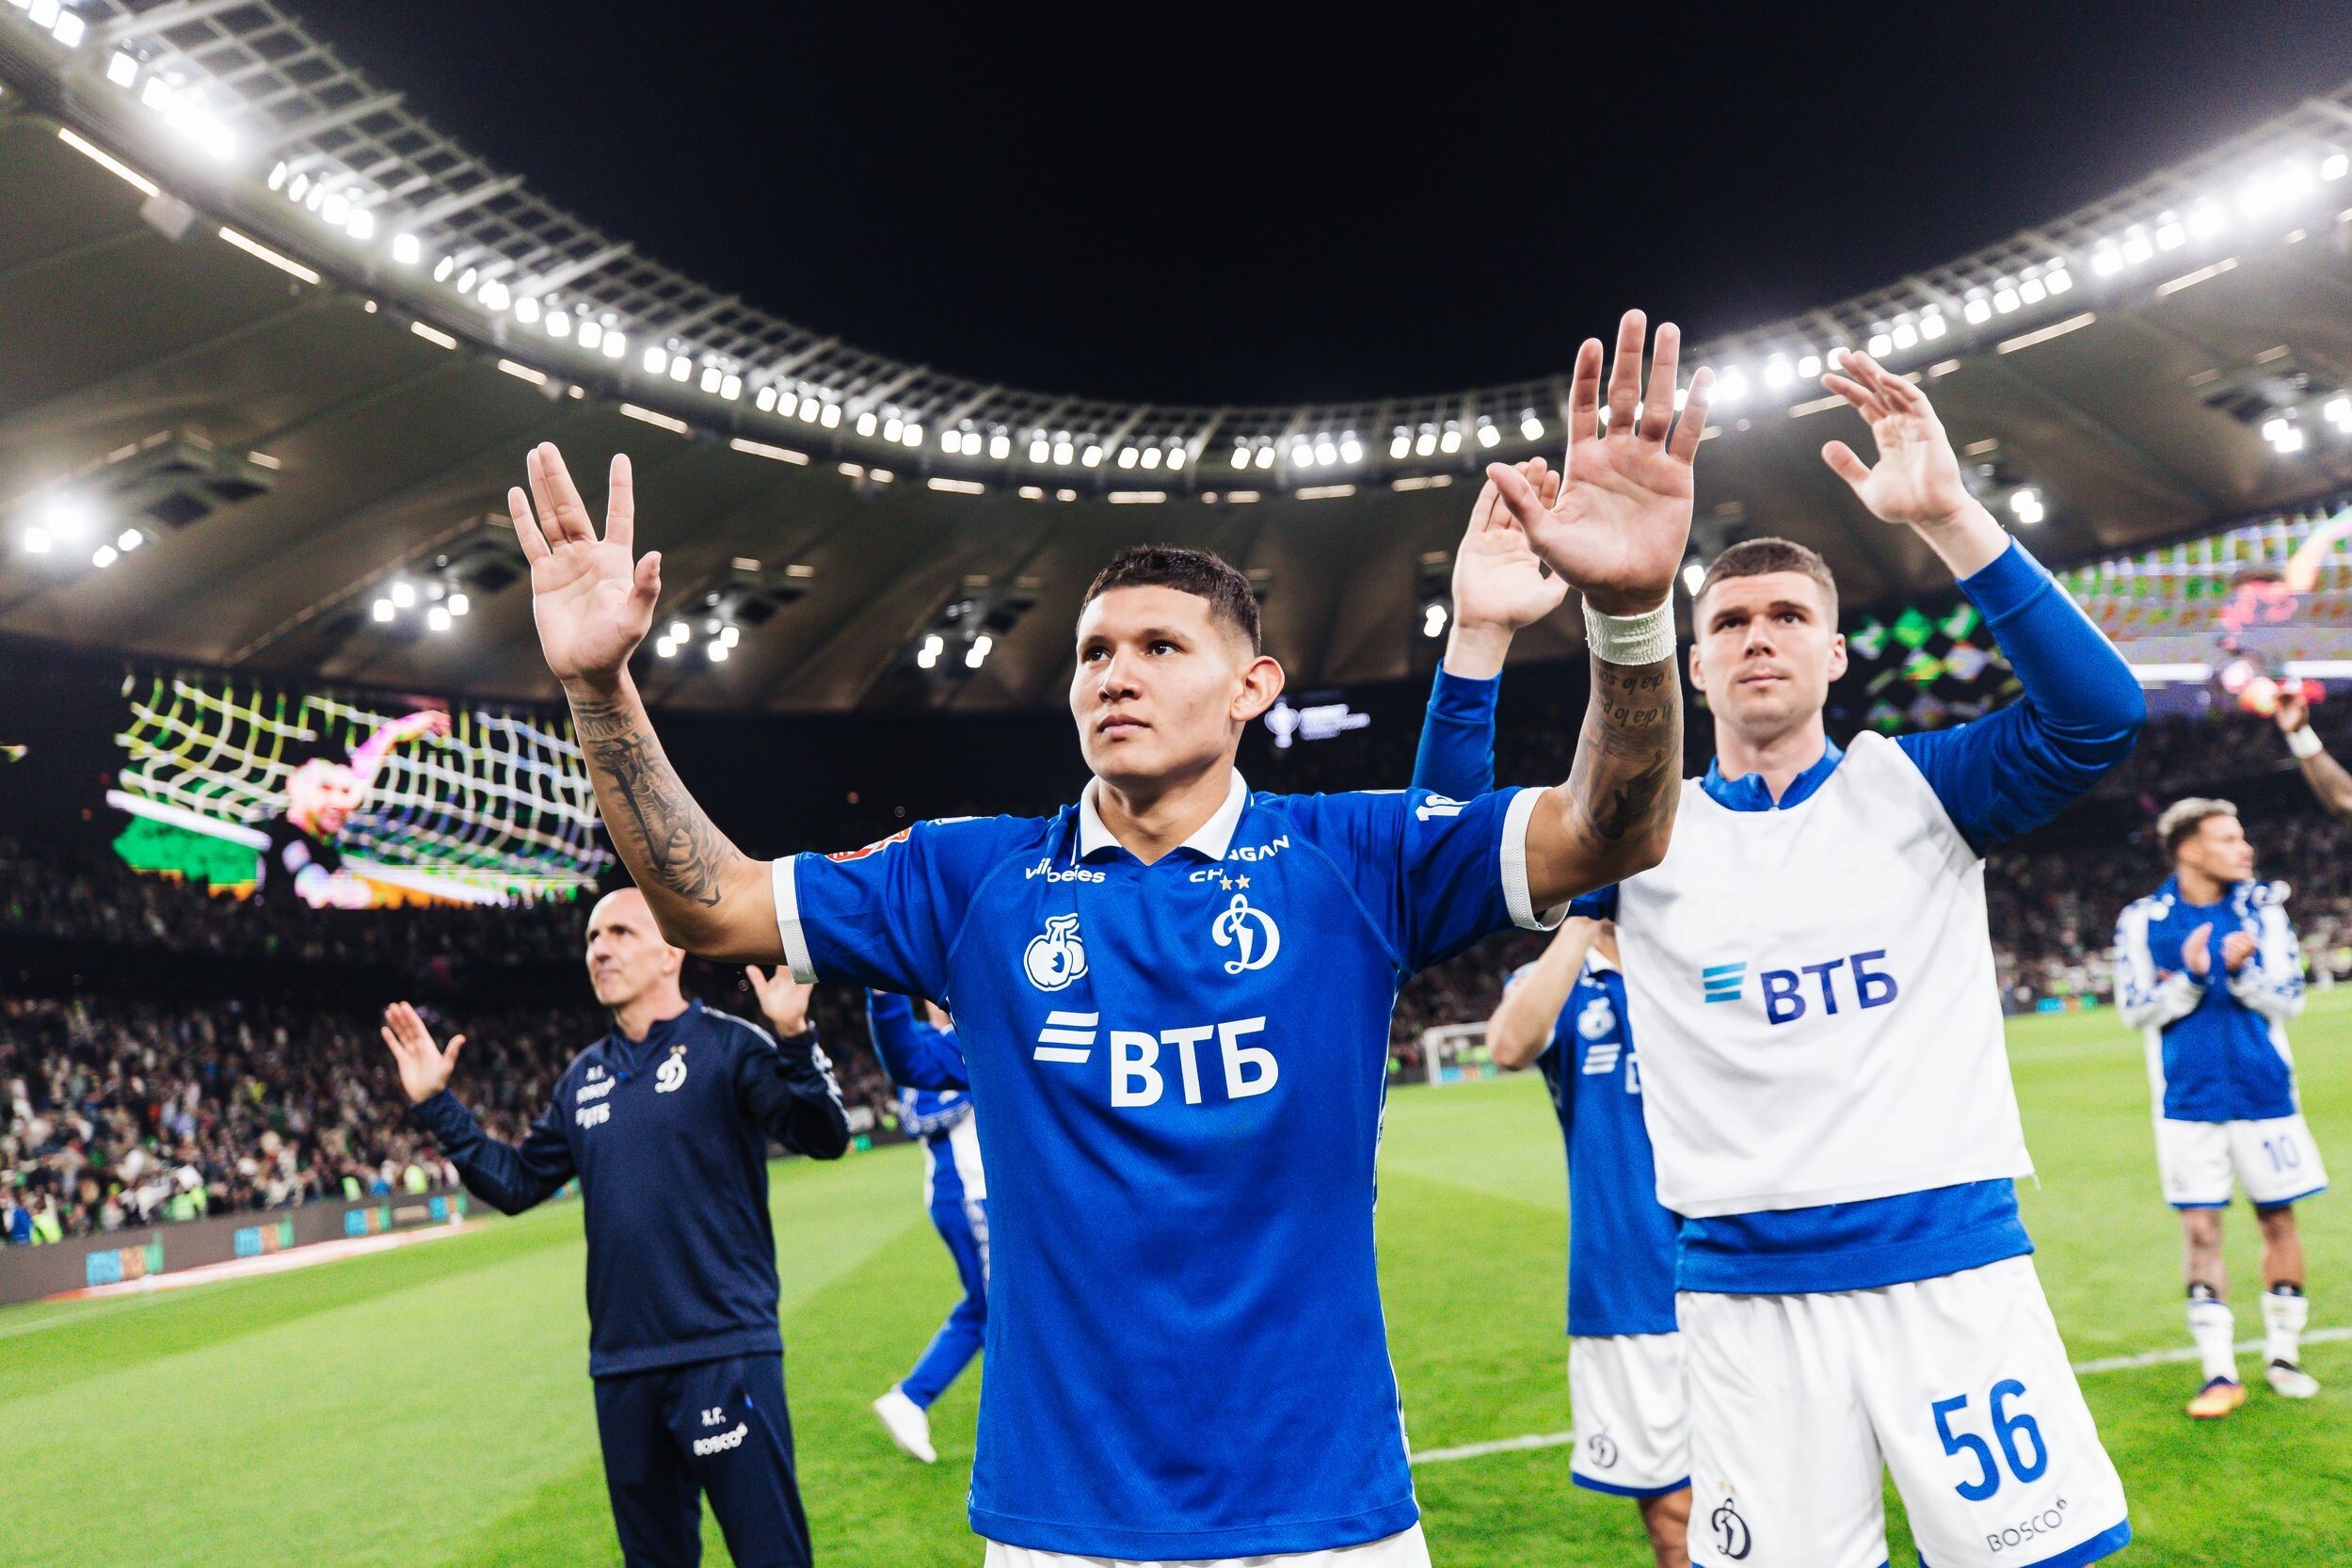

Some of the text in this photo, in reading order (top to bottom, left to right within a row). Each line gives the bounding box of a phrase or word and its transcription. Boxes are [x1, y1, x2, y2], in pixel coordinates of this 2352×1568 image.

[1759, 948, 1899, 1026] ВТБ
[1110, 1016, 1280, 1108] ВТБ
[2263, 1133, 2301, 1173] 10
[1931, 1378, 2049, 1502] 56
[1986, 1509, 2064, 1553] BOSCO
